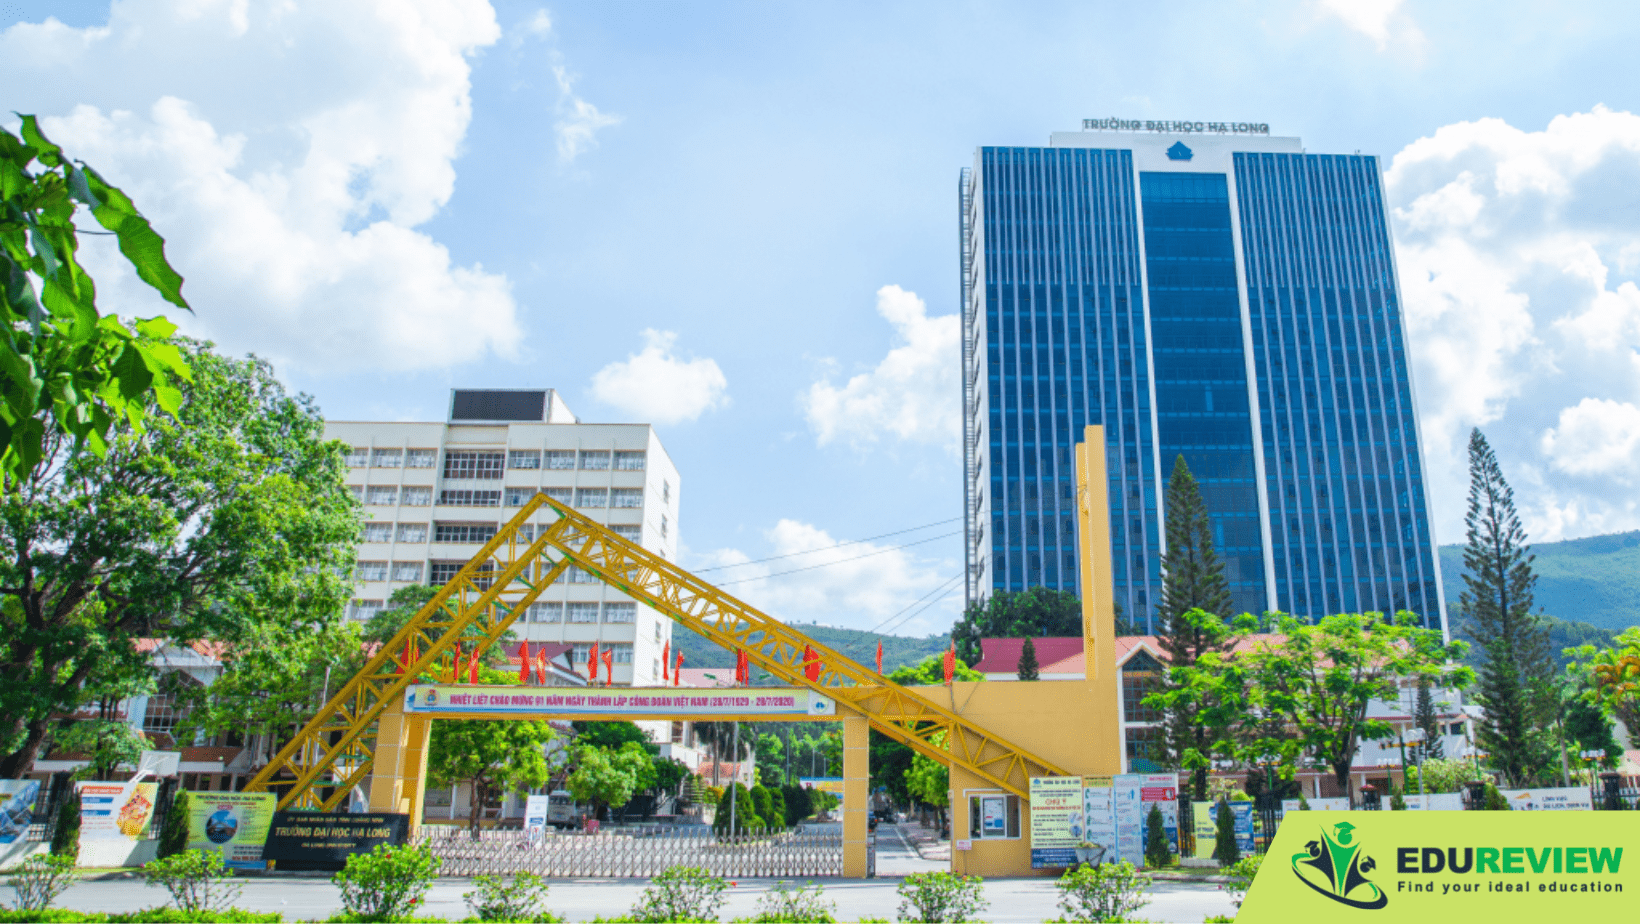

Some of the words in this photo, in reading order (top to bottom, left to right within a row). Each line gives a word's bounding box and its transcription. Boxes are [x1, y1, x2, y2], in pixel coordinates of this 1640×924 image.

[1082, 117, 1141, 130] TRƯỜNG
[1145, 119, 1169, 133] ĐẠI
[1173, 120, 1204, 134] HỌC
[1232, 122, 1269, 134] LONG
[690, 696, 708, 707] NAM
[275, 825, 312, 838] TRƯỜNG
[313, 827, 331, 839] ĐẠI
[331, 827, 350, 839] HỌC
[366, 827, 391, 838] LONG
